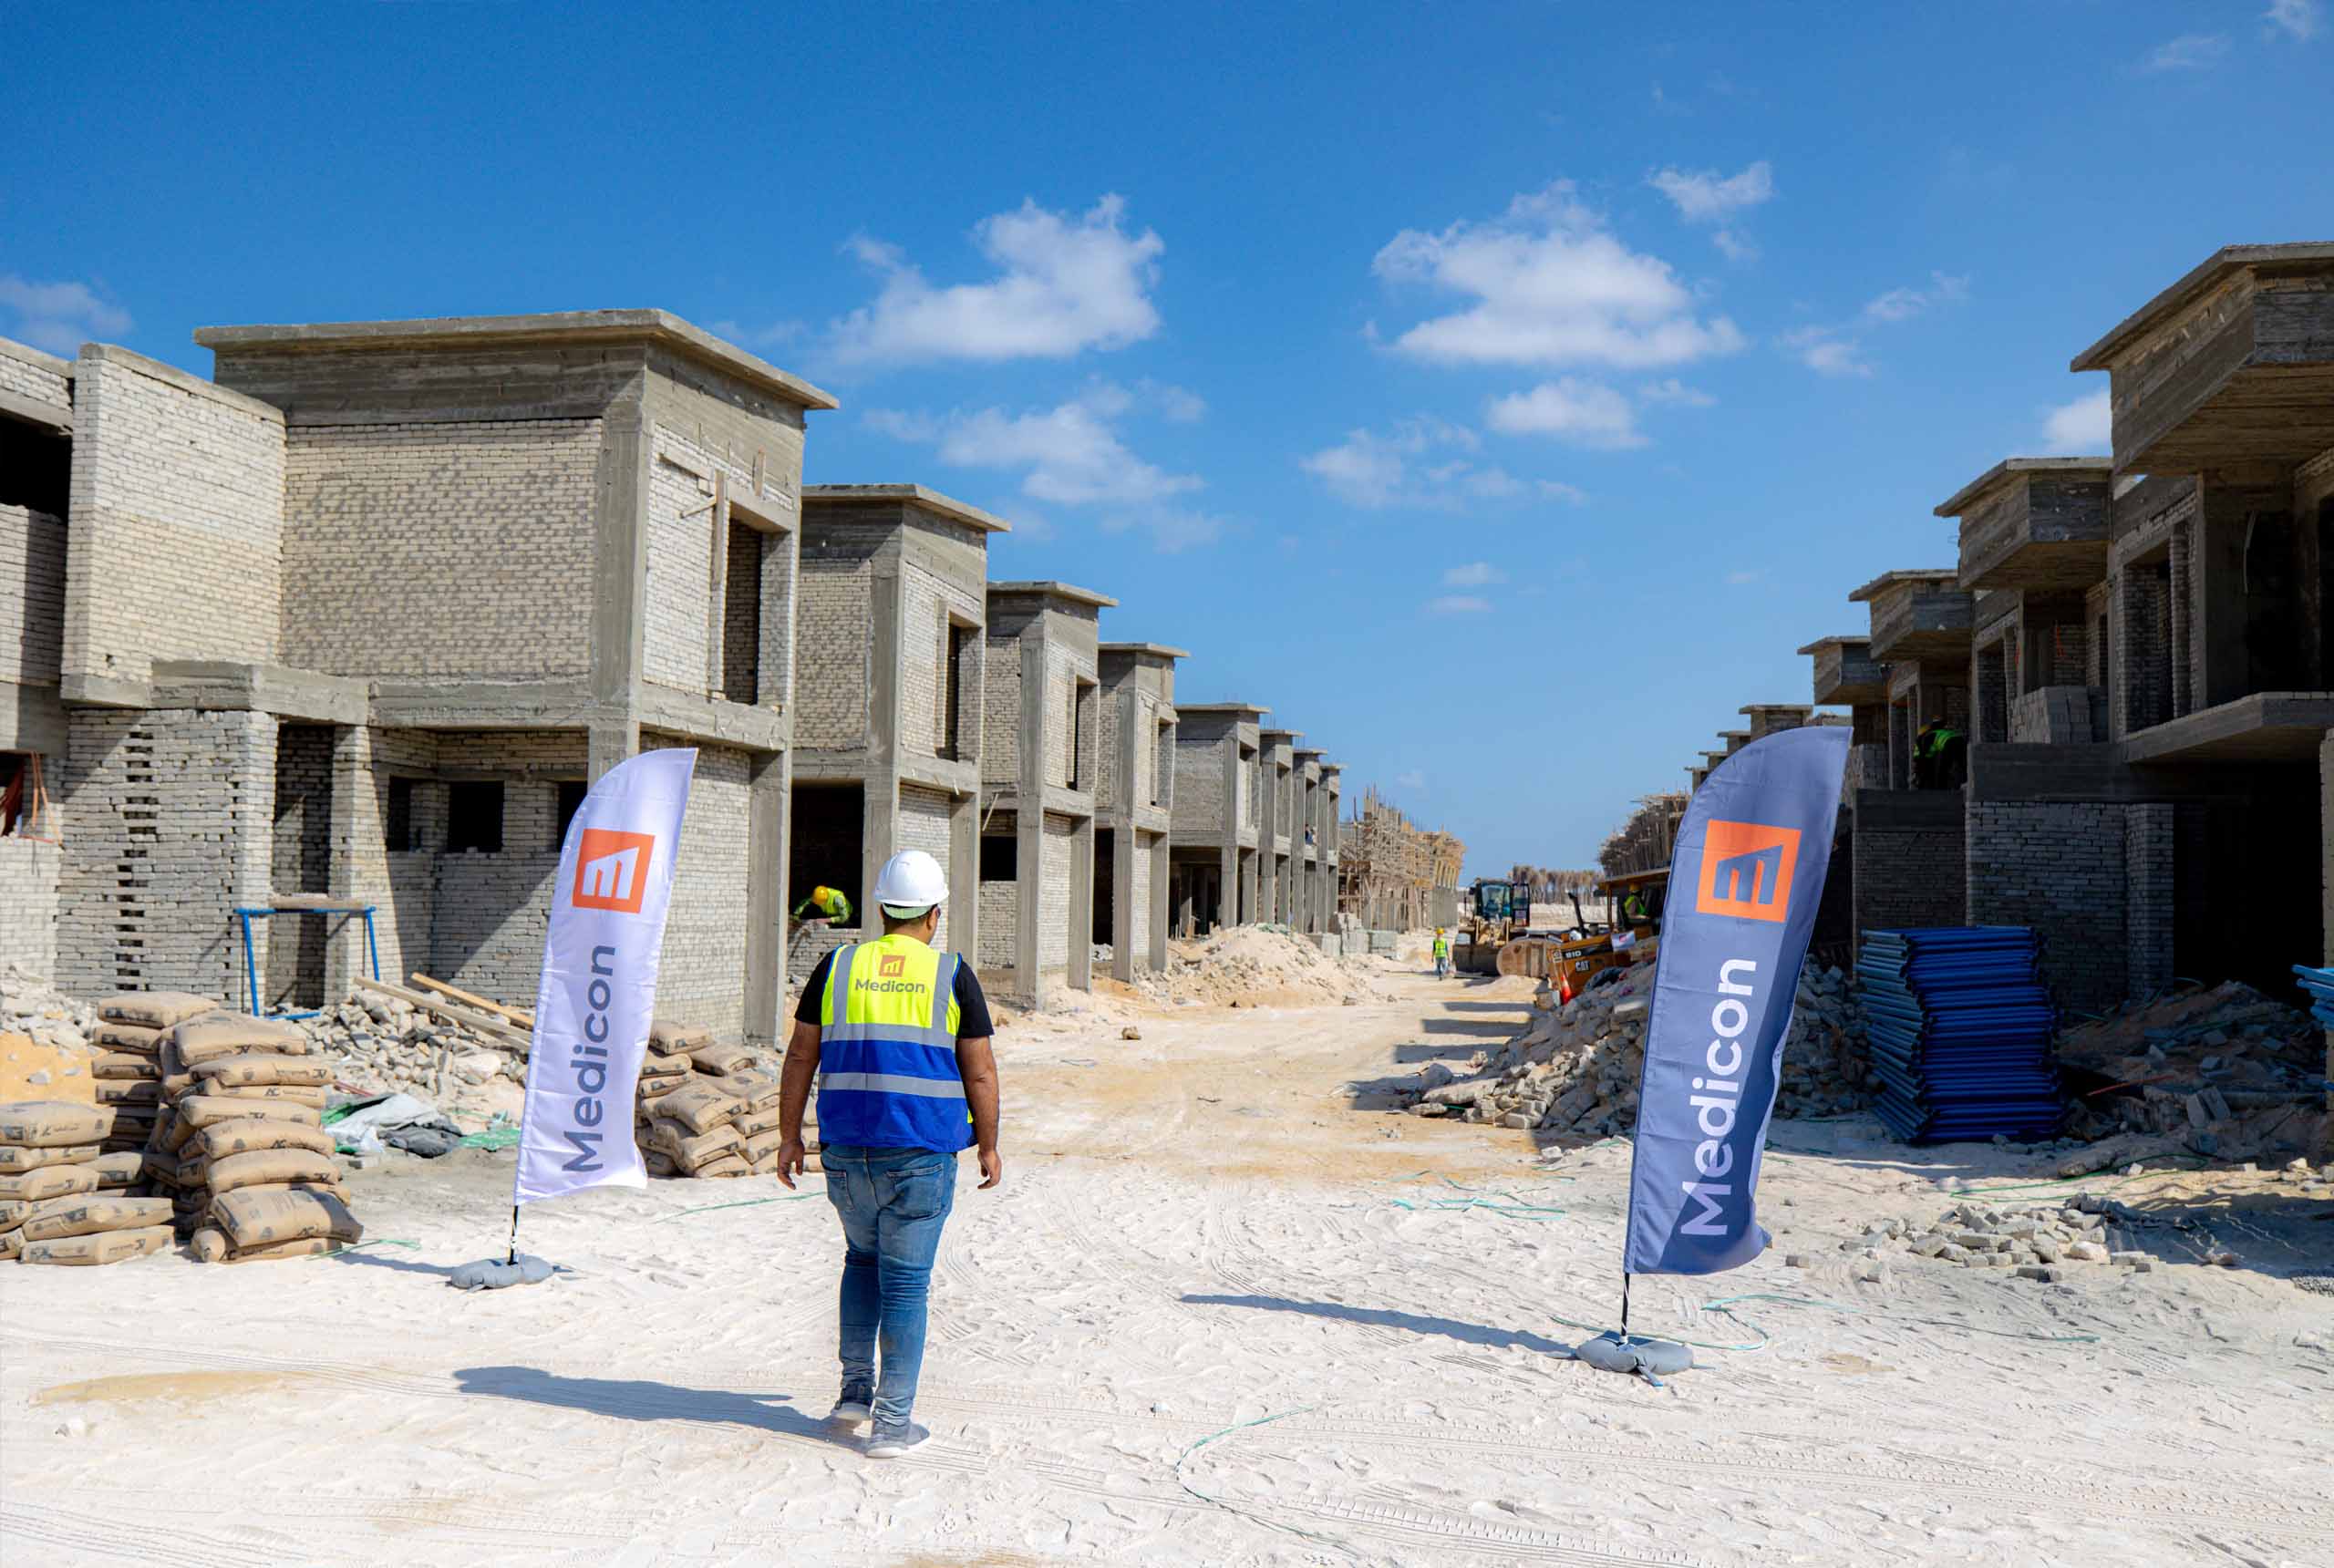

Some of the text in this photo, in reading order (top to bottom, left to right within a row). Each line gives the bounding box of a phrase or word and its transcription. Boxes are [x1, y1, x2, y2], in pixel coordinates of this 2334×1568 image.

[855, 978, 925, 994] Medicon
[1575, 961, 1589, 971] CAT
[562, 944, 616, 1172] Medicon
[1680, 957, 1758, 1236] Medicon
